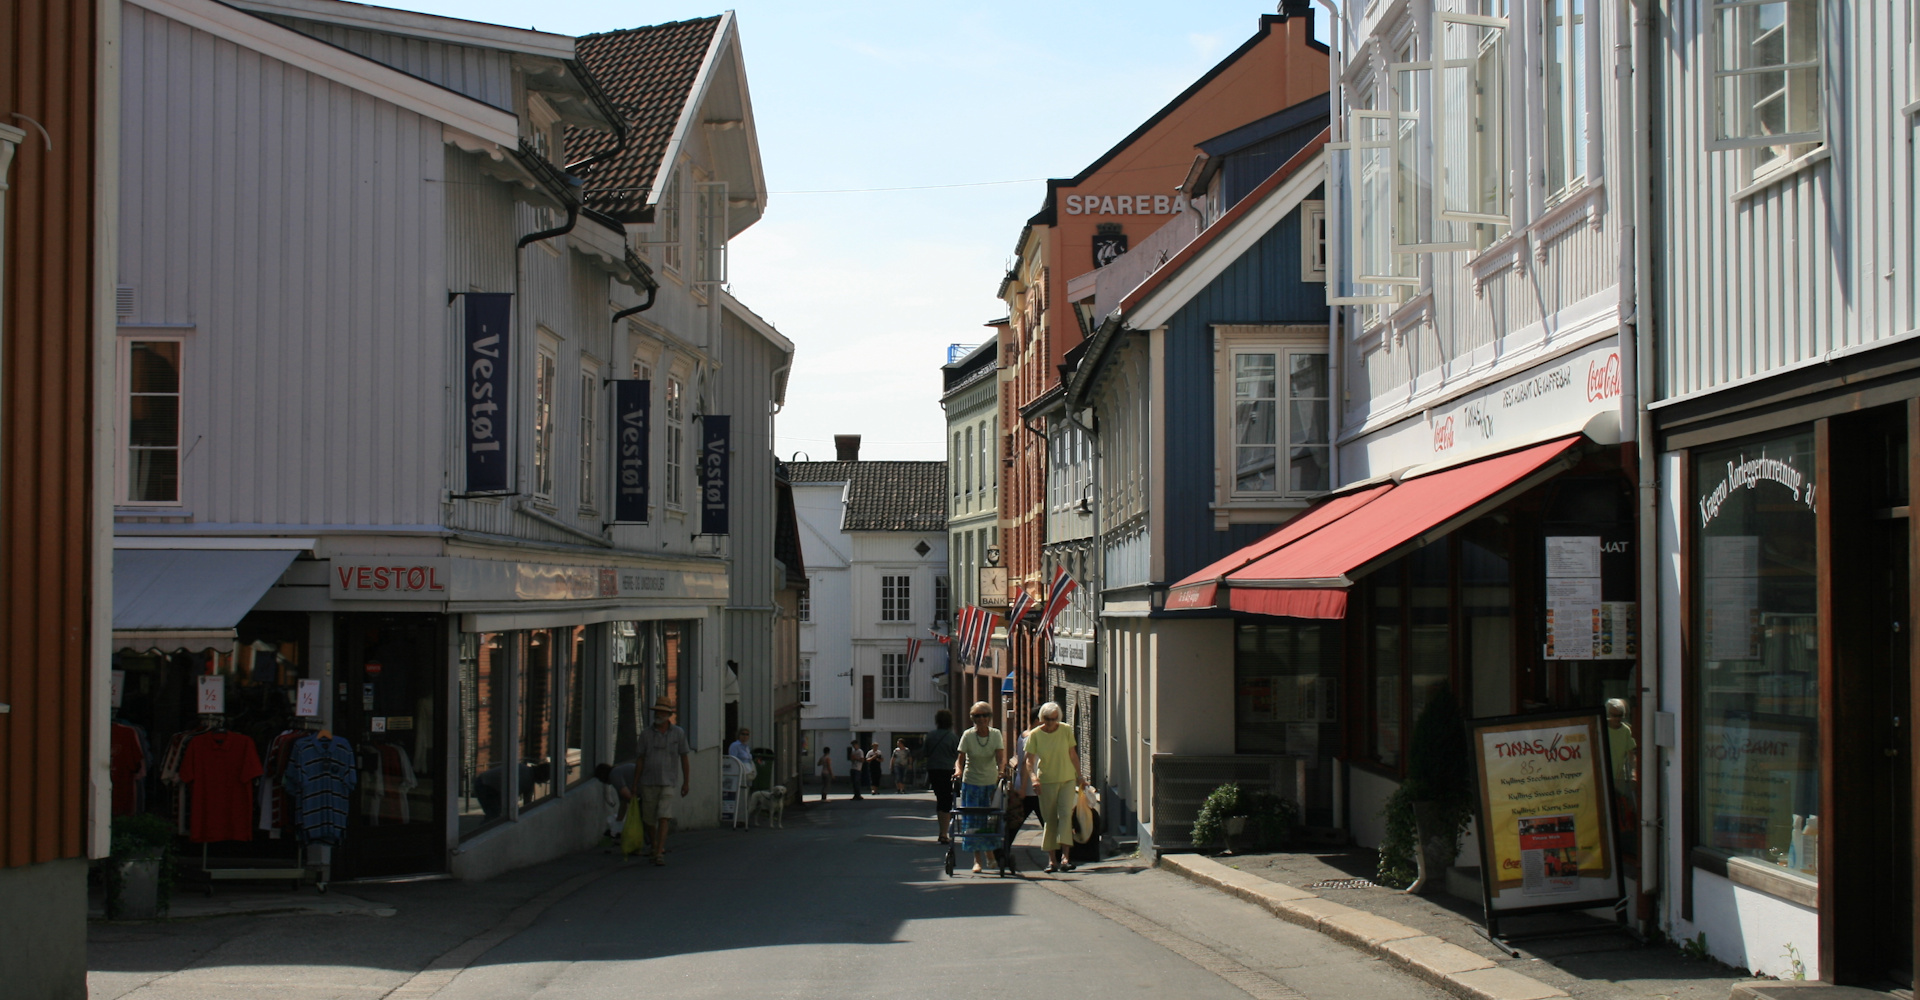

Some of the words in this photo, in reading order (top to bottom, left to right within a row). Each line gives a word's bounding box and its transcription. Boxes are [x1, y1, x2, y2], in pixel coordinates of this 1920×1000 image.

[337, 565, 444, 592] VESTØL
[982, 596, 1005, 605] BANK
[1495, 740, 1545, 758] TINAS
[1544, 739, 1582, 762] WOK
